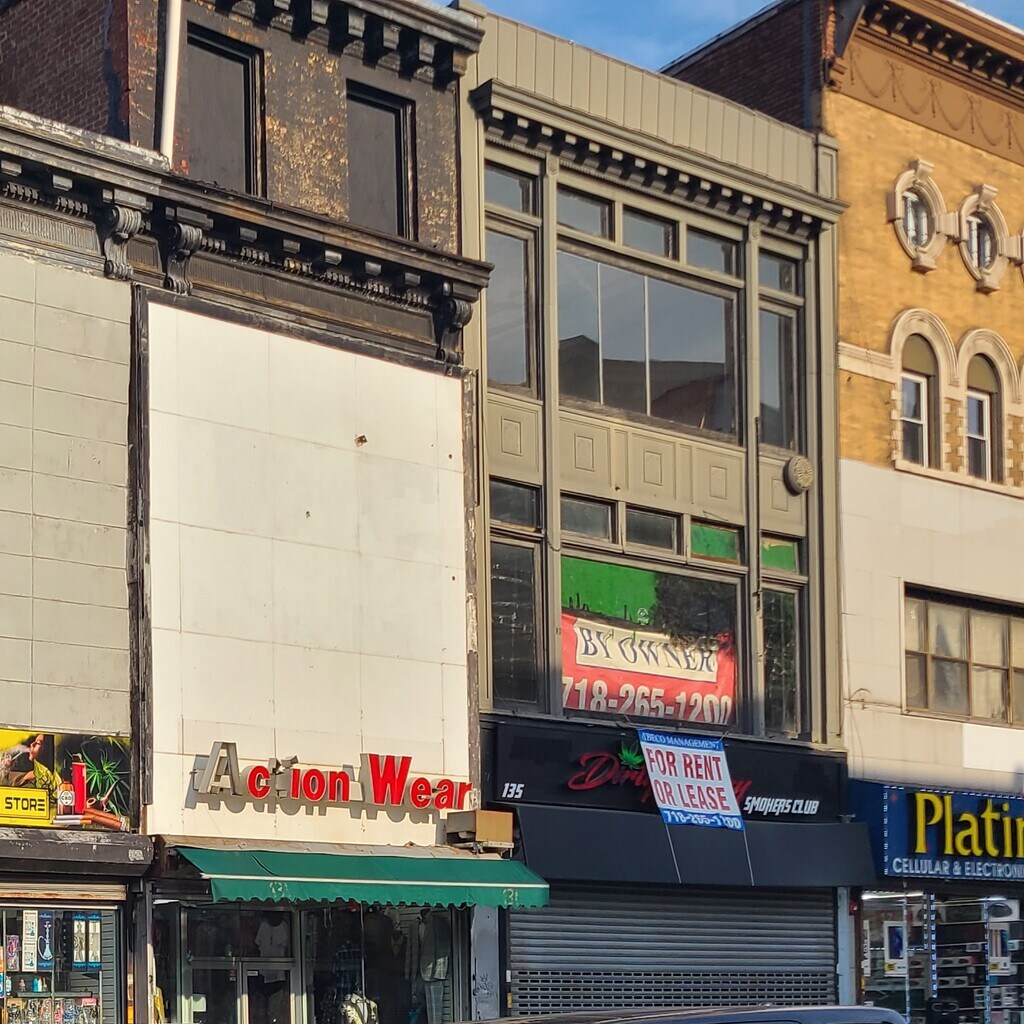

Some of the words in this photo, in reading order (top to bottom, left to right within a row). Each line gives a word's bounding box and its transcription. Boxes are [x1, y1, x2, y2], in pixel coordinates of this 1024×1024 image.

[579, 626, 613, 659] BY
[618, 637, 716, 672] OWNER
[562, 676, 733, 725] 718-265-1200
[666, 736, 720, 749] MANAGEMENT
[645, 748, 678, 777] FOR
[682, 752, 723, 781] RENT
[364, 753, 473, 810] Wear
[501, 782, 525, 799] 135
[4, 796, 45, 812] STORE
[653, 779, 677, 806] OR
[677, 783, 731, 811] LEASE
[791, 799, 820, 815] CLUB
[892, 858, 950, 875] CELLULAR
[952, 860, 962, 875] &
